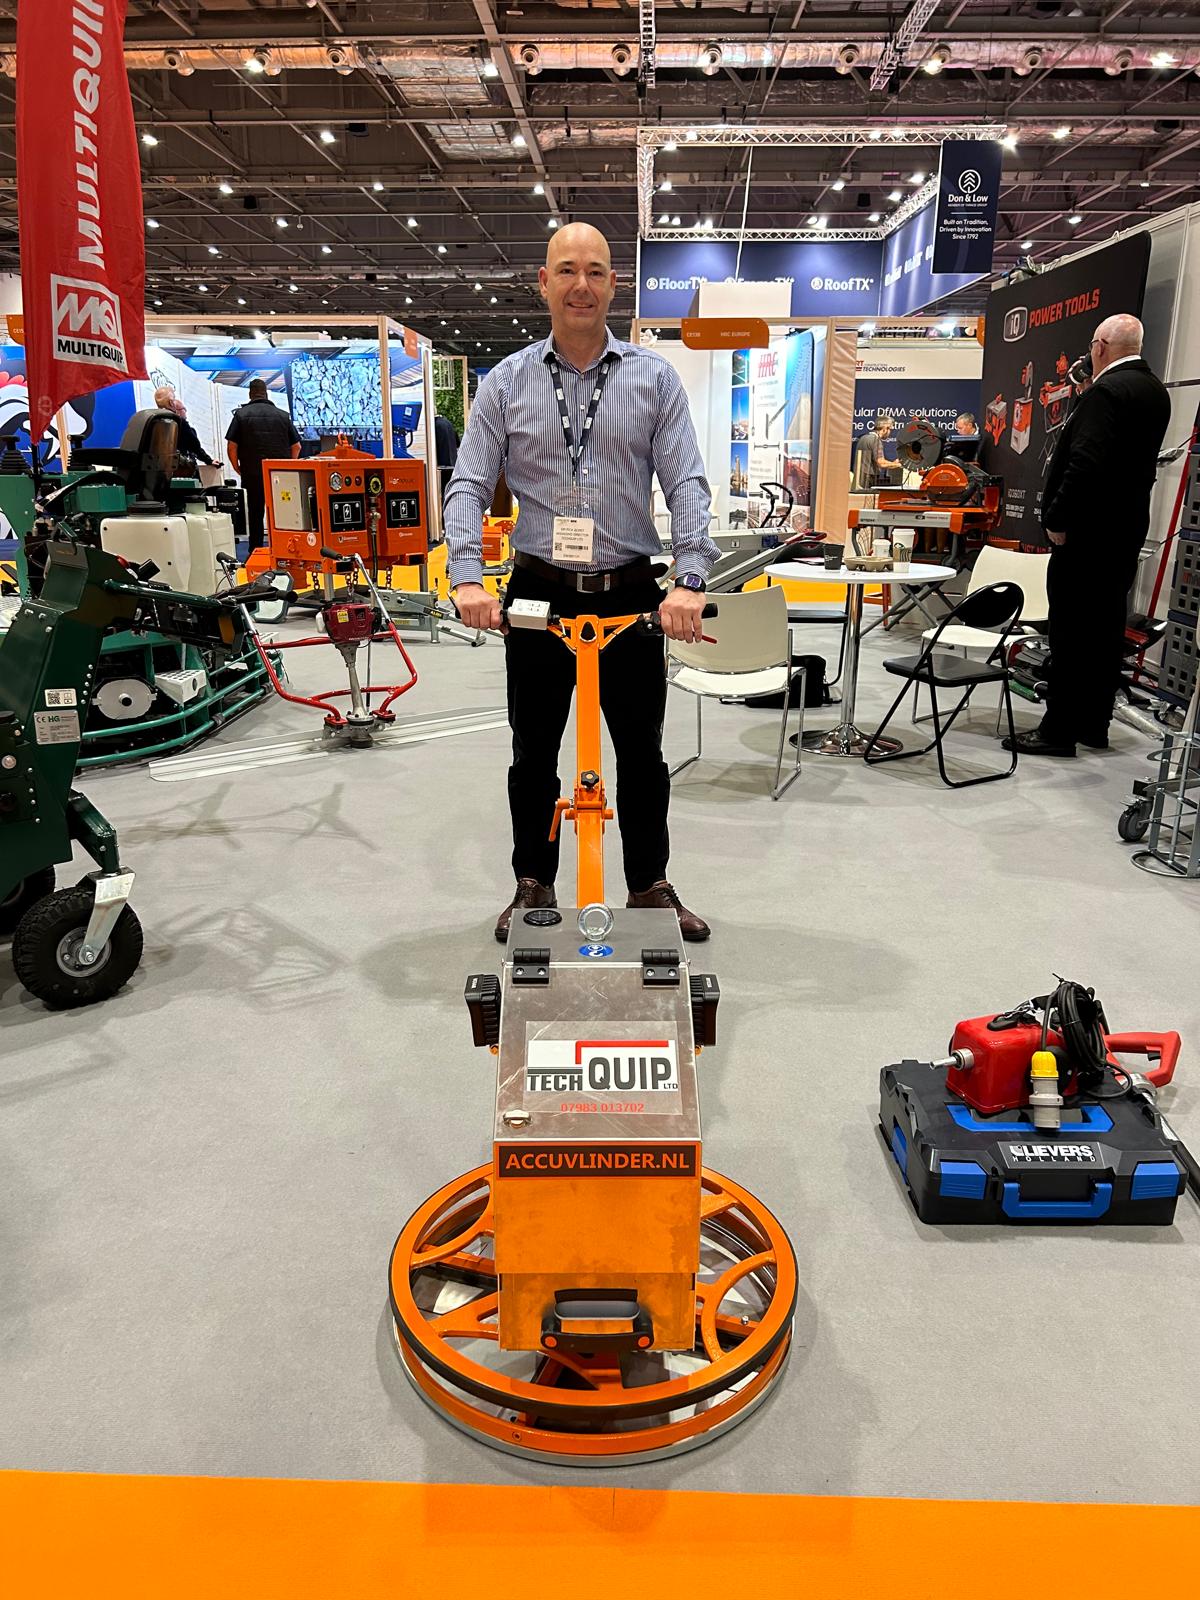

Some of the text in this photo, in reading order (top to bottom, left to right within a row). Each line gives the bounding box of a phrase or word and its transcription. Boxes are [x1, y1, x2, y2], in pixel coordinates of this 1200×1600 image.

[948, 194, 989, 203] Don & Low
[1029, 302, 1062, 329] POWER
[1064, 288, 1100, 318] TOOLS
[854, 407, 958, 417] ular DfMA solutions
[48, 715, 60, 723] HG
[528, 1075, 583, 1091] TECH
[588, 1057, 671, 1091] QUIP
[561, 1103, 644, 1112] 07983 013702
[1023, 1145, 1093, 1157] LIEVERS
[505, 1153, 690, 1169] ACCUVLINDER.NL
